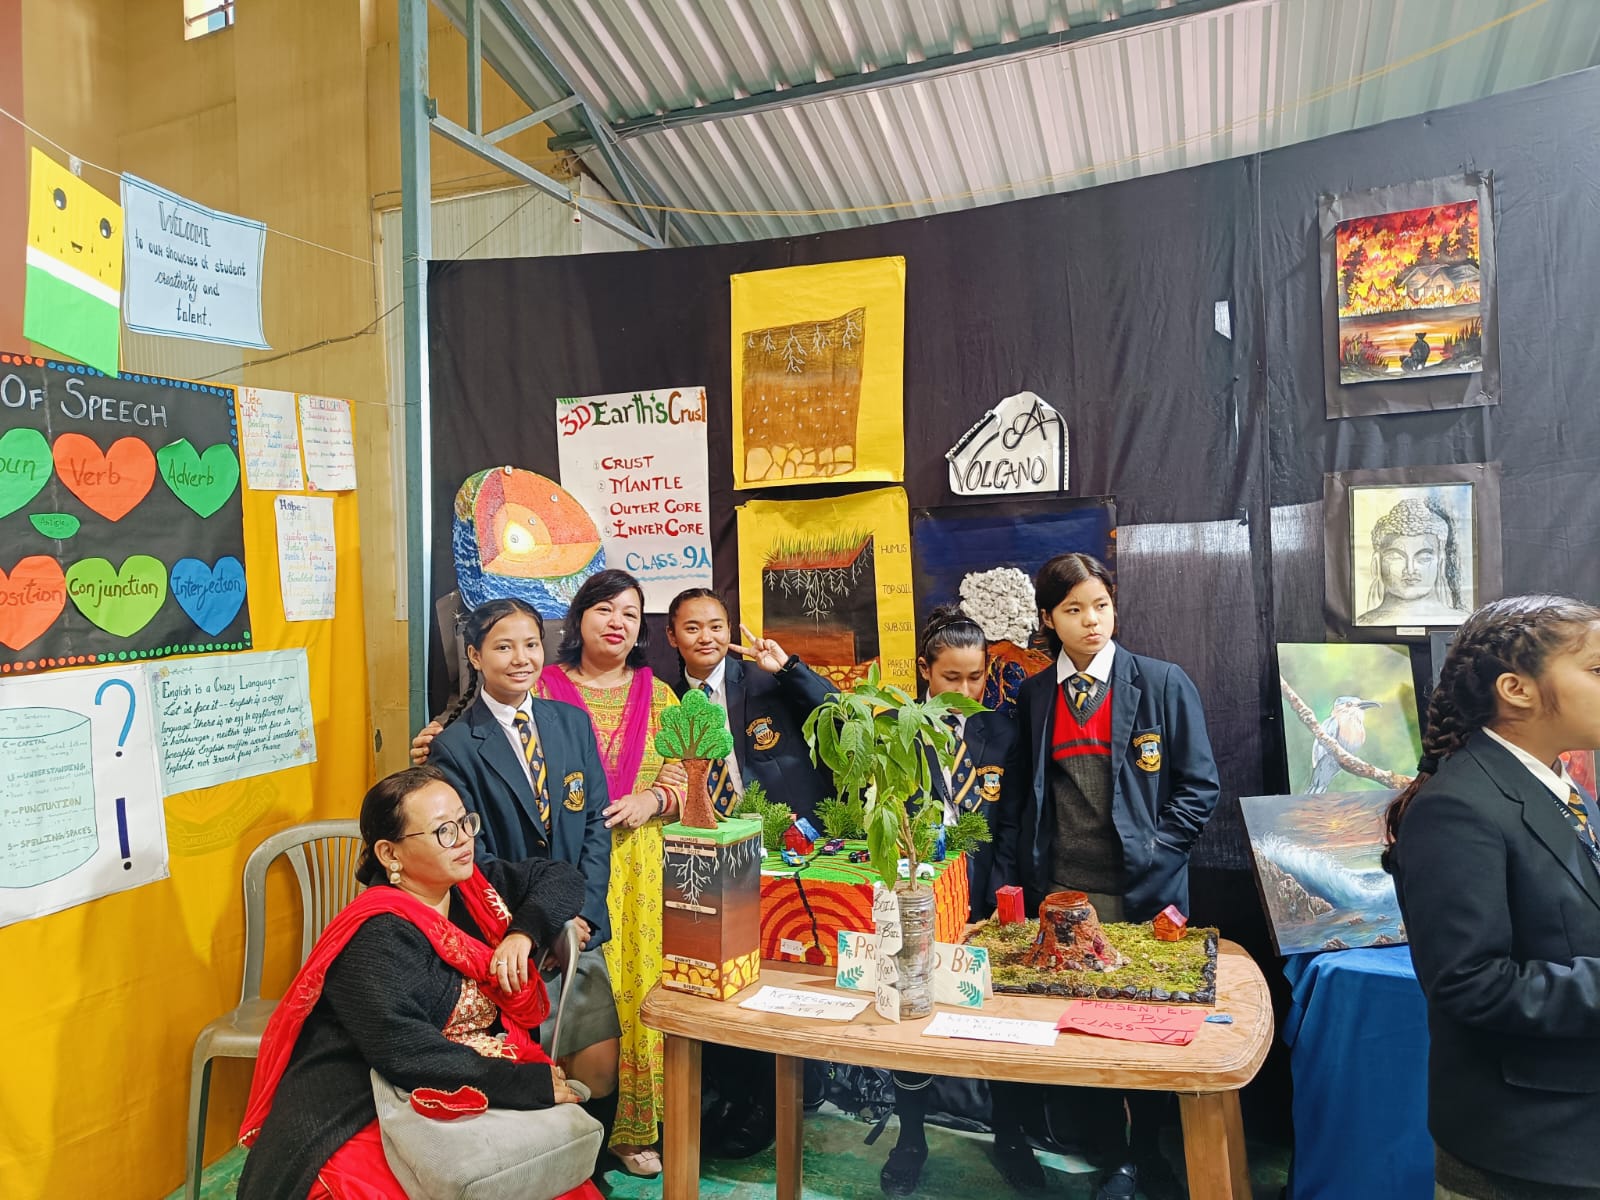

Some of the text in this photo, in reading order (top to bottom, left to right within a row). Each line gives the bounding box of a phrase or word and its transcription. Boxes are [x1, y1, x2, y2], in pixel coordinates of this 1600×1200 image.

[158, 200, 211, 247] WELCOME
[135, 228, 143, 249] to
[149, 242, 162, 256] our
[166, 245, 198, 267] showcase
[215, 259, 246, 276] student
[155, 270, 220, 303] creativity and
[60, 378, 168, 428] SPEECH
[560, 391, 706, 436] 3D Earth's Crust
[70, 458, 121, 486] Verb
[601, 455, 654, 470] CRUST
[952, 431, 1047, 492] VOLCANO
[168, 459, 215, 490] Adverb
[609, 474, 683, 494] MANTLE
[610, 502, 659, 516] OUTER
[664, 499, 702, 514] CORE
[612, 519, 664, 538] INNER
[665, 519, 704, 536] CORE
[626, 546, 711, 571] CLASS 9A
[881, 543, 907, 554] HUMUS
[69, 575, 159, 608] Conjunction
[173, 568, 242, 611] Interjection
[888, 658, 913, 669] PARENT
[162, 681, 191, 700] English
[195, 684, 202, 694] is
[206, 685, 211, 693] a
[214, 676, 235, 695] Crazy
[163, 701, 180, 716] Let
[1081, 1001, 1193, 1015] PRESENTED
[1137, 1014, 1172, 1024] BY
